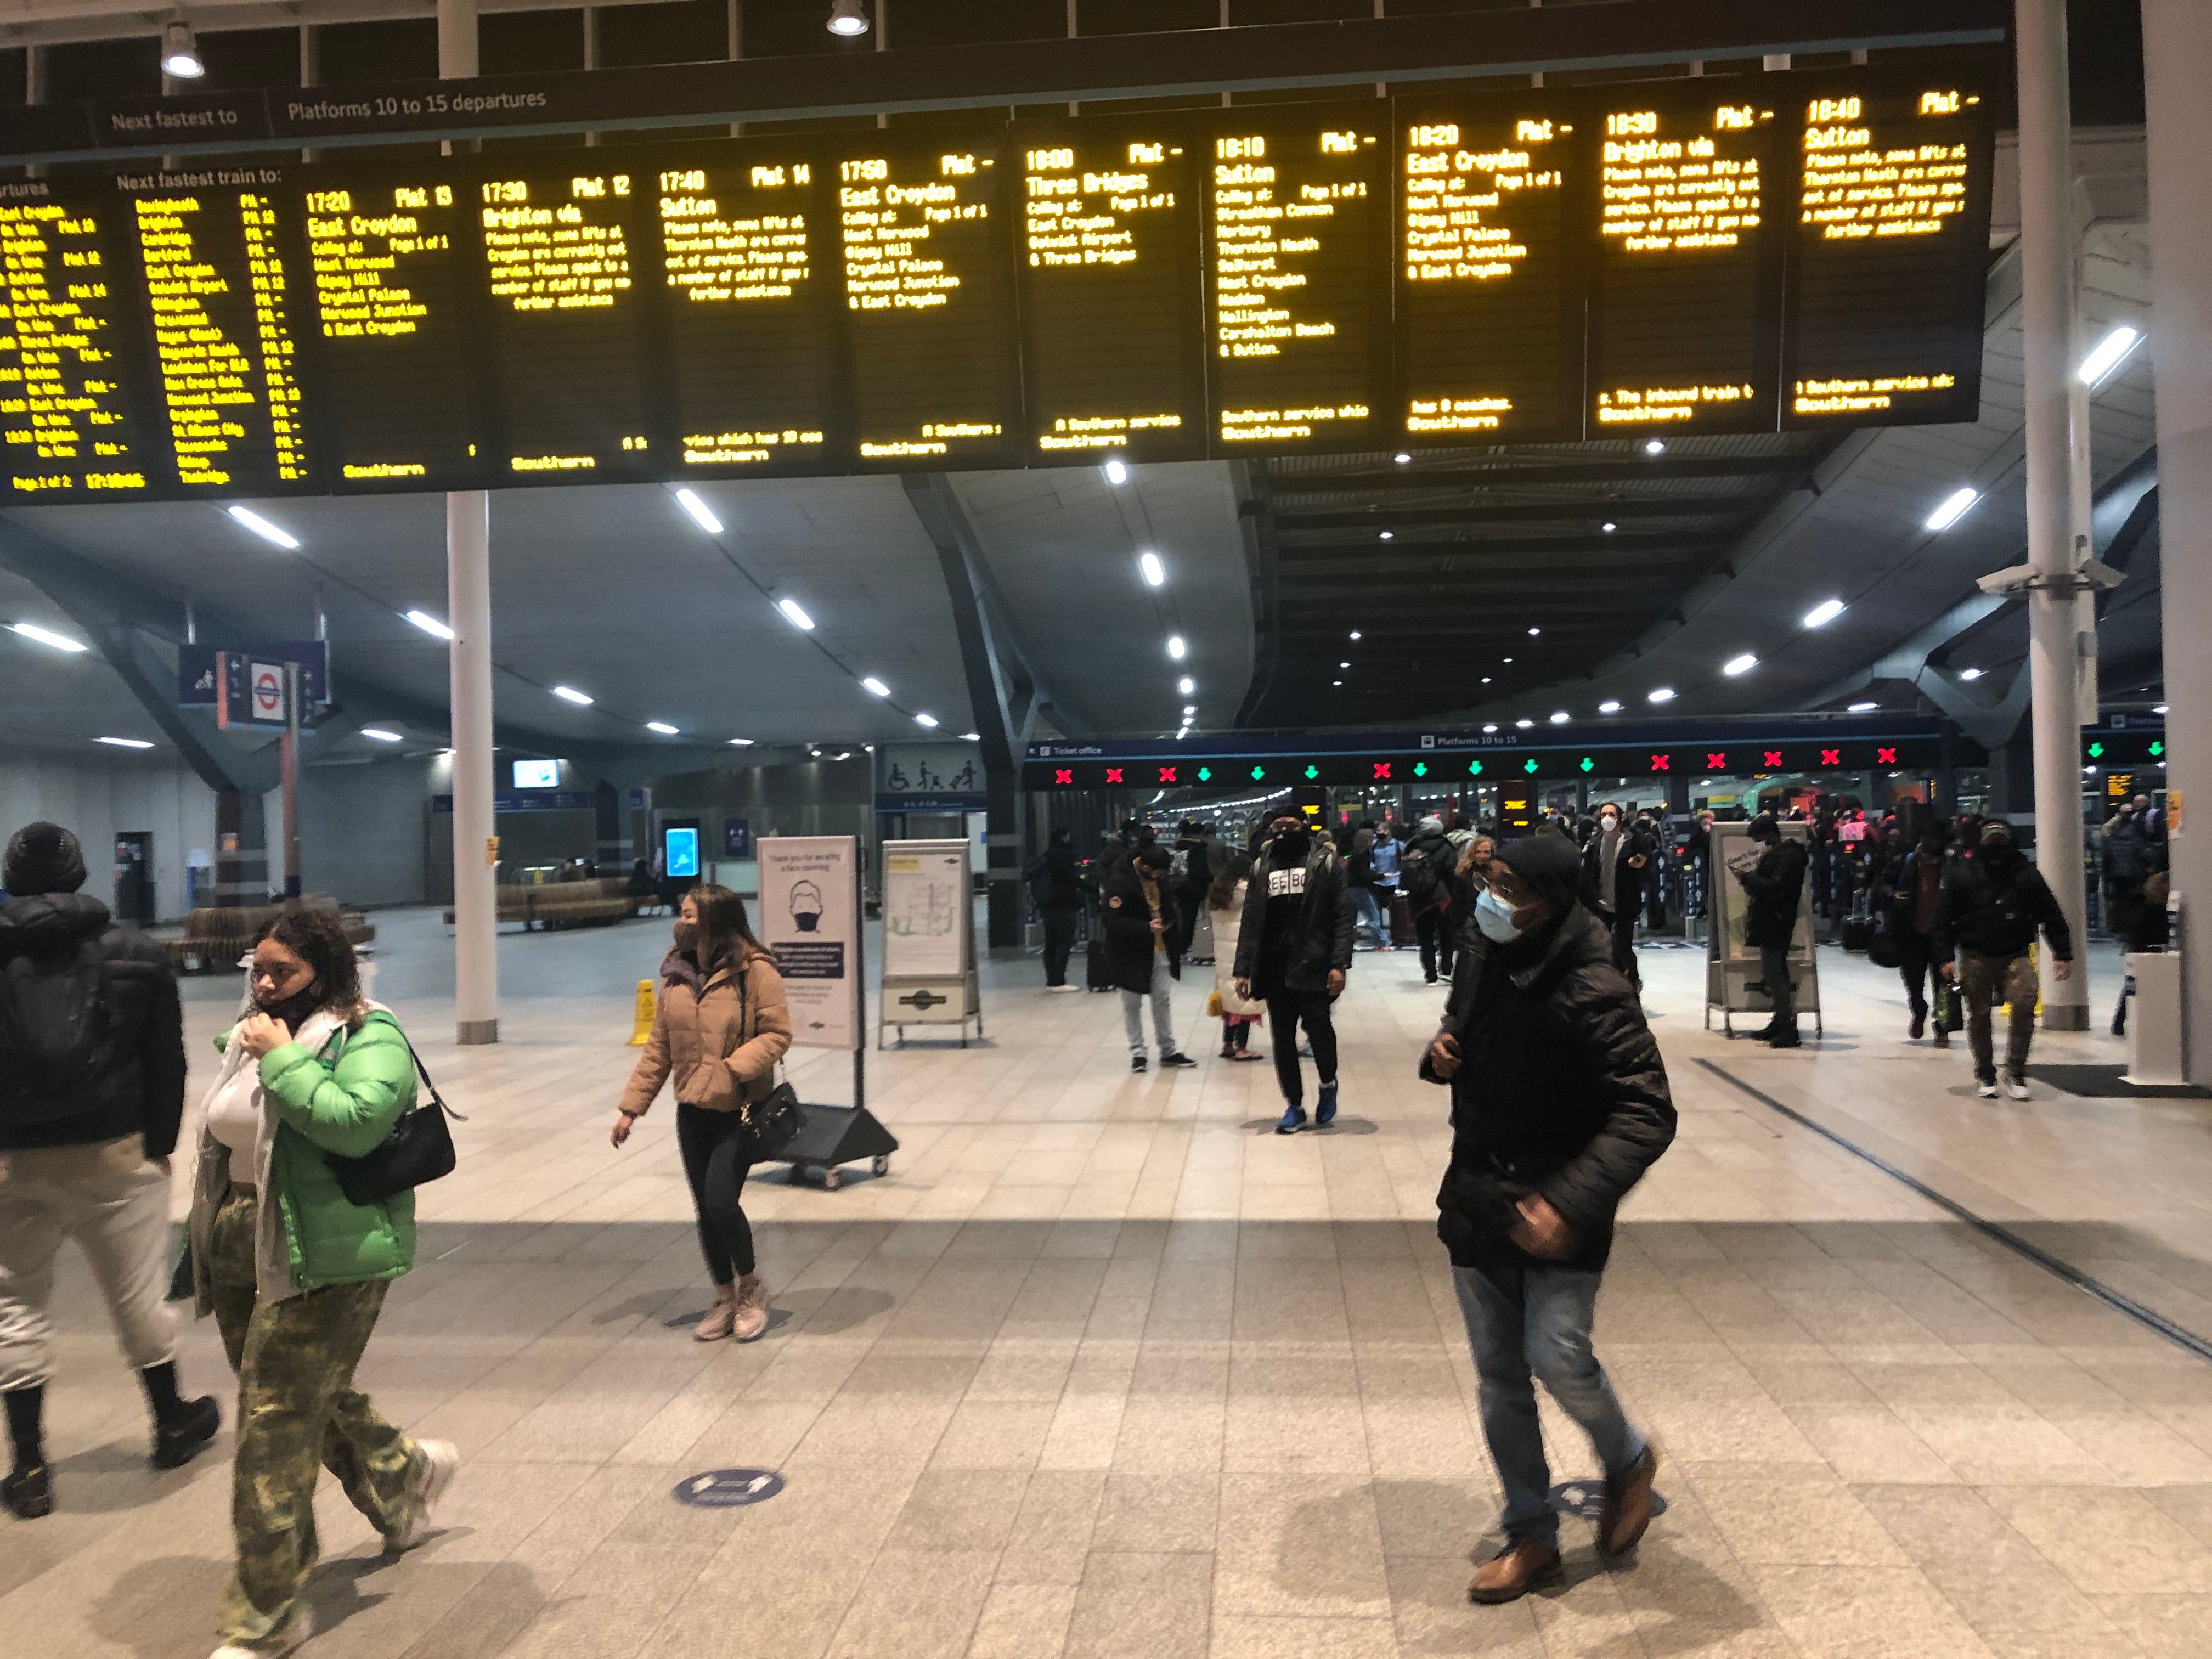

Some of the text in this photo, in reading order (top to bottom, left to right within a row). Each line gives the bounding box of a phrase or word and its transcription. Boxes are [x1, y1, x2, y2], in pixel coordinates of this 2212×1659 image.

[289, 93, 546, 120] Platforms 10 to 15 departures
[1809, 91, 1959, 122] 18:40 Plat
[111, 110, 237, 130] Next fastest to
[1607, 105, 1753, 136] 18:30 Plat
[1216, 131, 1357, 159] 18:10 Plat
[1409, 119, 1553, 147] 18:20 Plat
[1804, 126, 1870, 150] Sutton
[1026, 142, 1164, 171] 18:00 Plat
[1406, 148, 1530, 175] East Croydon
[1603, 136, 1715, 163] Brighton via
[117, 167, 281, 190] Next fastest train to:
[659, 163, 810, 192] 17:40 Plat 14
[840, 154, 976, 182] 17:50 Plat
[1214, 163, 1275, 186] Sutton
[482, 174, 630, 202] 17:30 Plat 12
[840, 182, 956, 208] East Croydon
[1025, 171, 1148, 197] Three Bridges
[306, 185, 452, 212] 17:20 Plat 13
[659, 196, 716, 218] Sutton
[307, 214, 417, 238] East Croydon
[482, 203, 582, 229] Brighton via
[1599, 405, 1692, 422] Southern
[1795, 396, 1890, 413] Southern
[1221, 425, 1311, 441] Southern
[1407, 415, 1498, 431] Southern
[860, 441, 946, 456] Southern
[1039, 433, 1127, 449] Southern
[511, 455, 595, 470] Southern
[684, 448, 769, 463] Southern
[343, 463, 425, 478] Southern
[1079, 746, 1102, 754] office
[1506, 736, 1517, 744] 15
